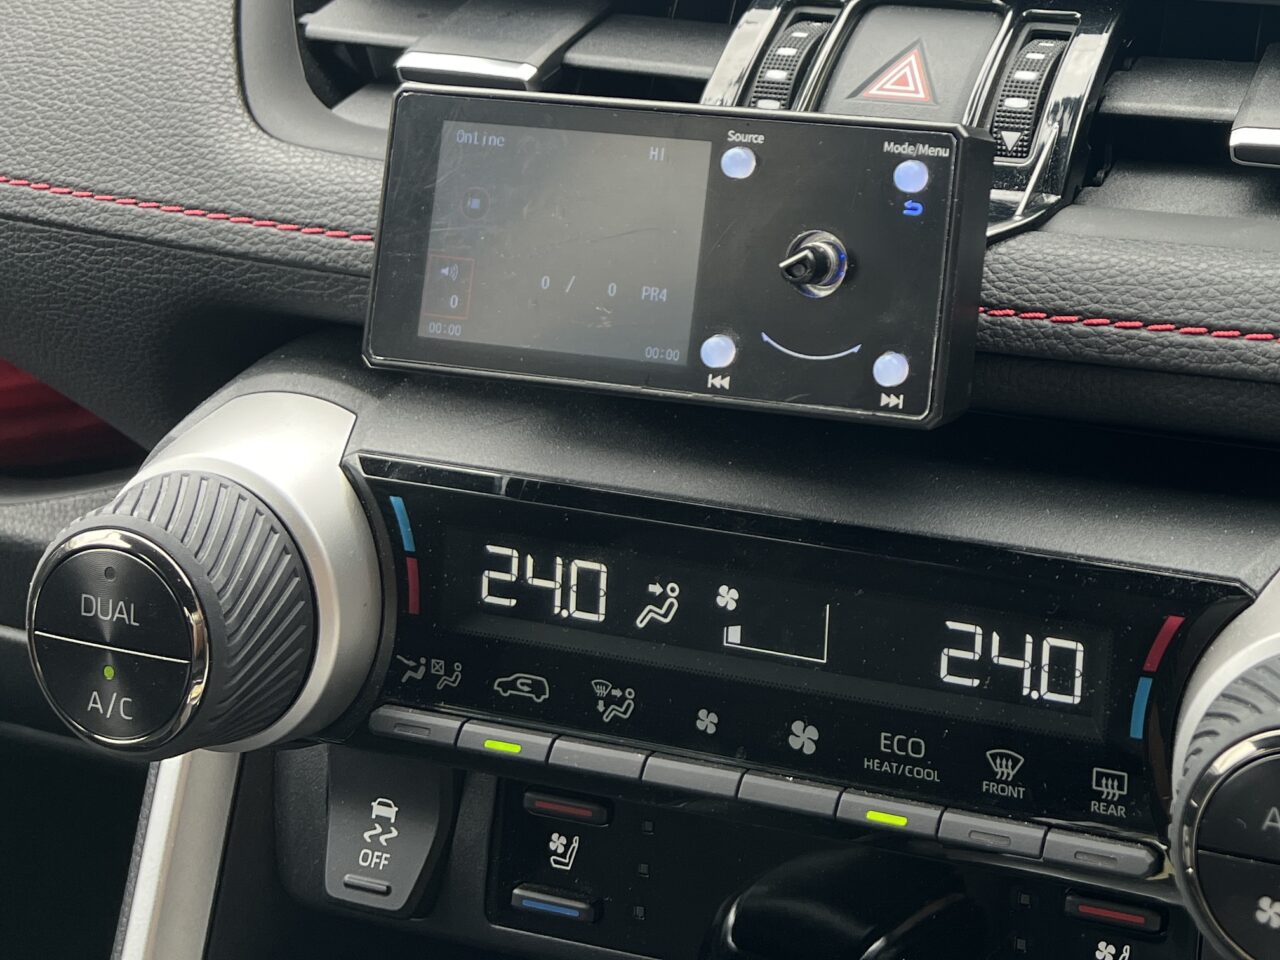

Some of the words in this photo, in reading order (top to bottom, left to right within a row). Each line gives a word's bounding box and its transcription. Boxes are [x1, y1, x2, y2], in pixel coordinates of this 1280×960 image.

[456, 128, 505, 147] Online
[727, 129, 765, 144] Source
[883, 141, 951, 158] Mode/Menu
[641, 286, 668, 303] PR4
[428, 321, 462, 337] 00:00
[645, 346, 681, 362] 00:00
[481, 543, 608, 623] 24.0
[80, 593, 140, 627] DUAL
[940, 619, 1085, 706] 24.0
[87, 690, 133, 721] A/C
[879, 731, 926, 759] ECO
[863, 757, 941, 783] HEAT/COOL
[982, 780, 1026, 800] FRONT
[1090, 800, 1127, 819] REAR
[358, 848, 391, 871] OFF
